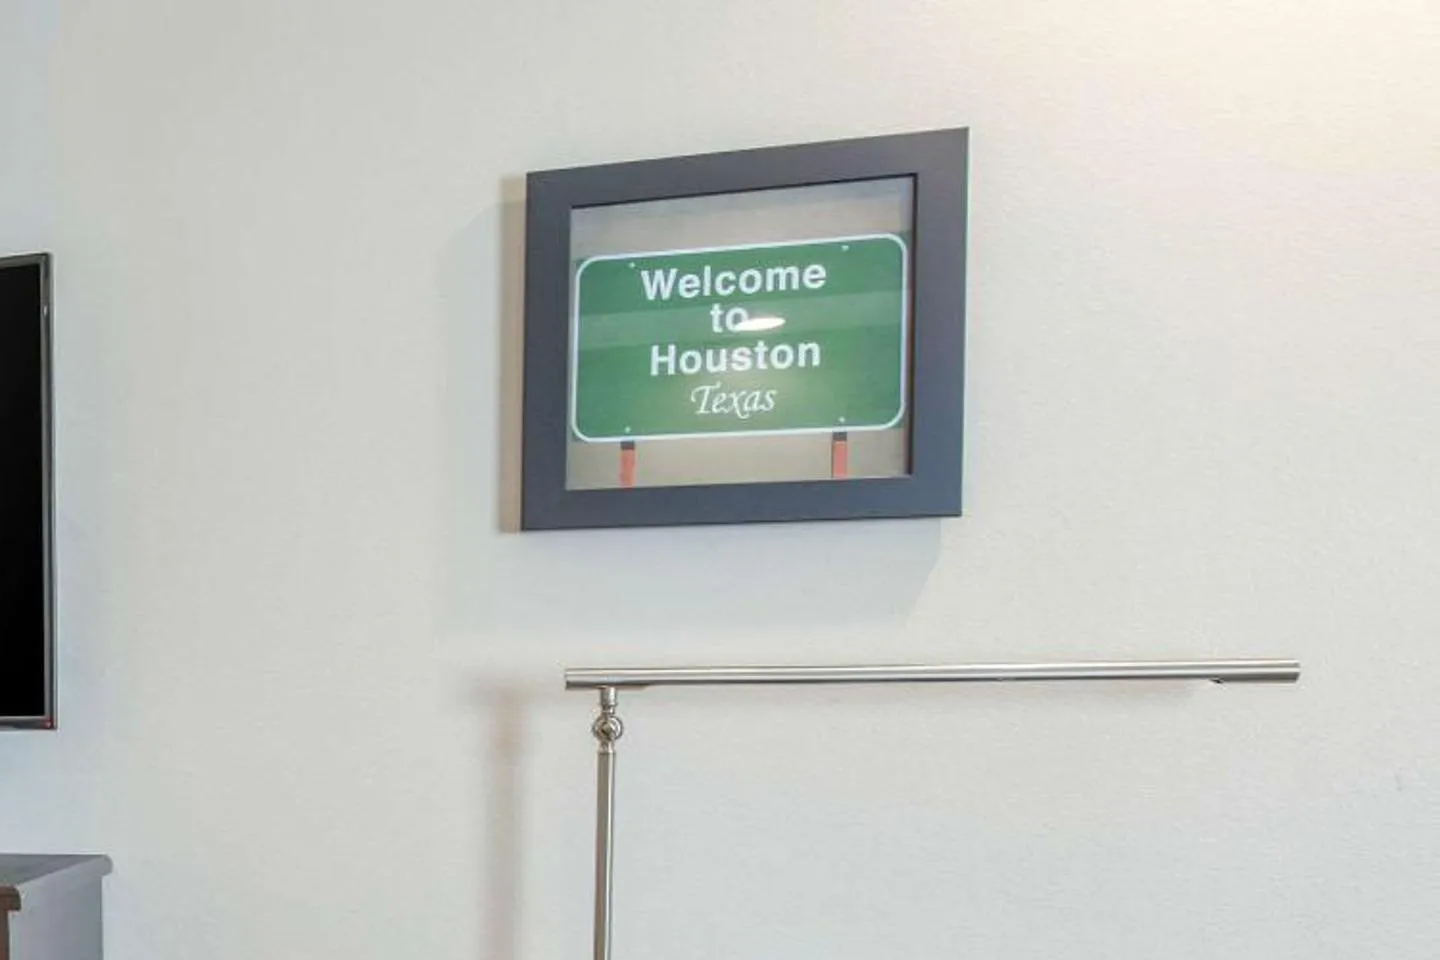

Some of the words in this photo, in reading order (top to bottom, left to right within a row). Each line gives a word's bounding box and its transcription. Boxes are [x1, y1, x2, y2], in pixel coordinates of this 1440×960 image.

[640, 264, 827, 301] Welcome
[710, 303, 749, 333] to
[650, 340, 821, 377] Houston
[690, 380, 778, 419] Texas
